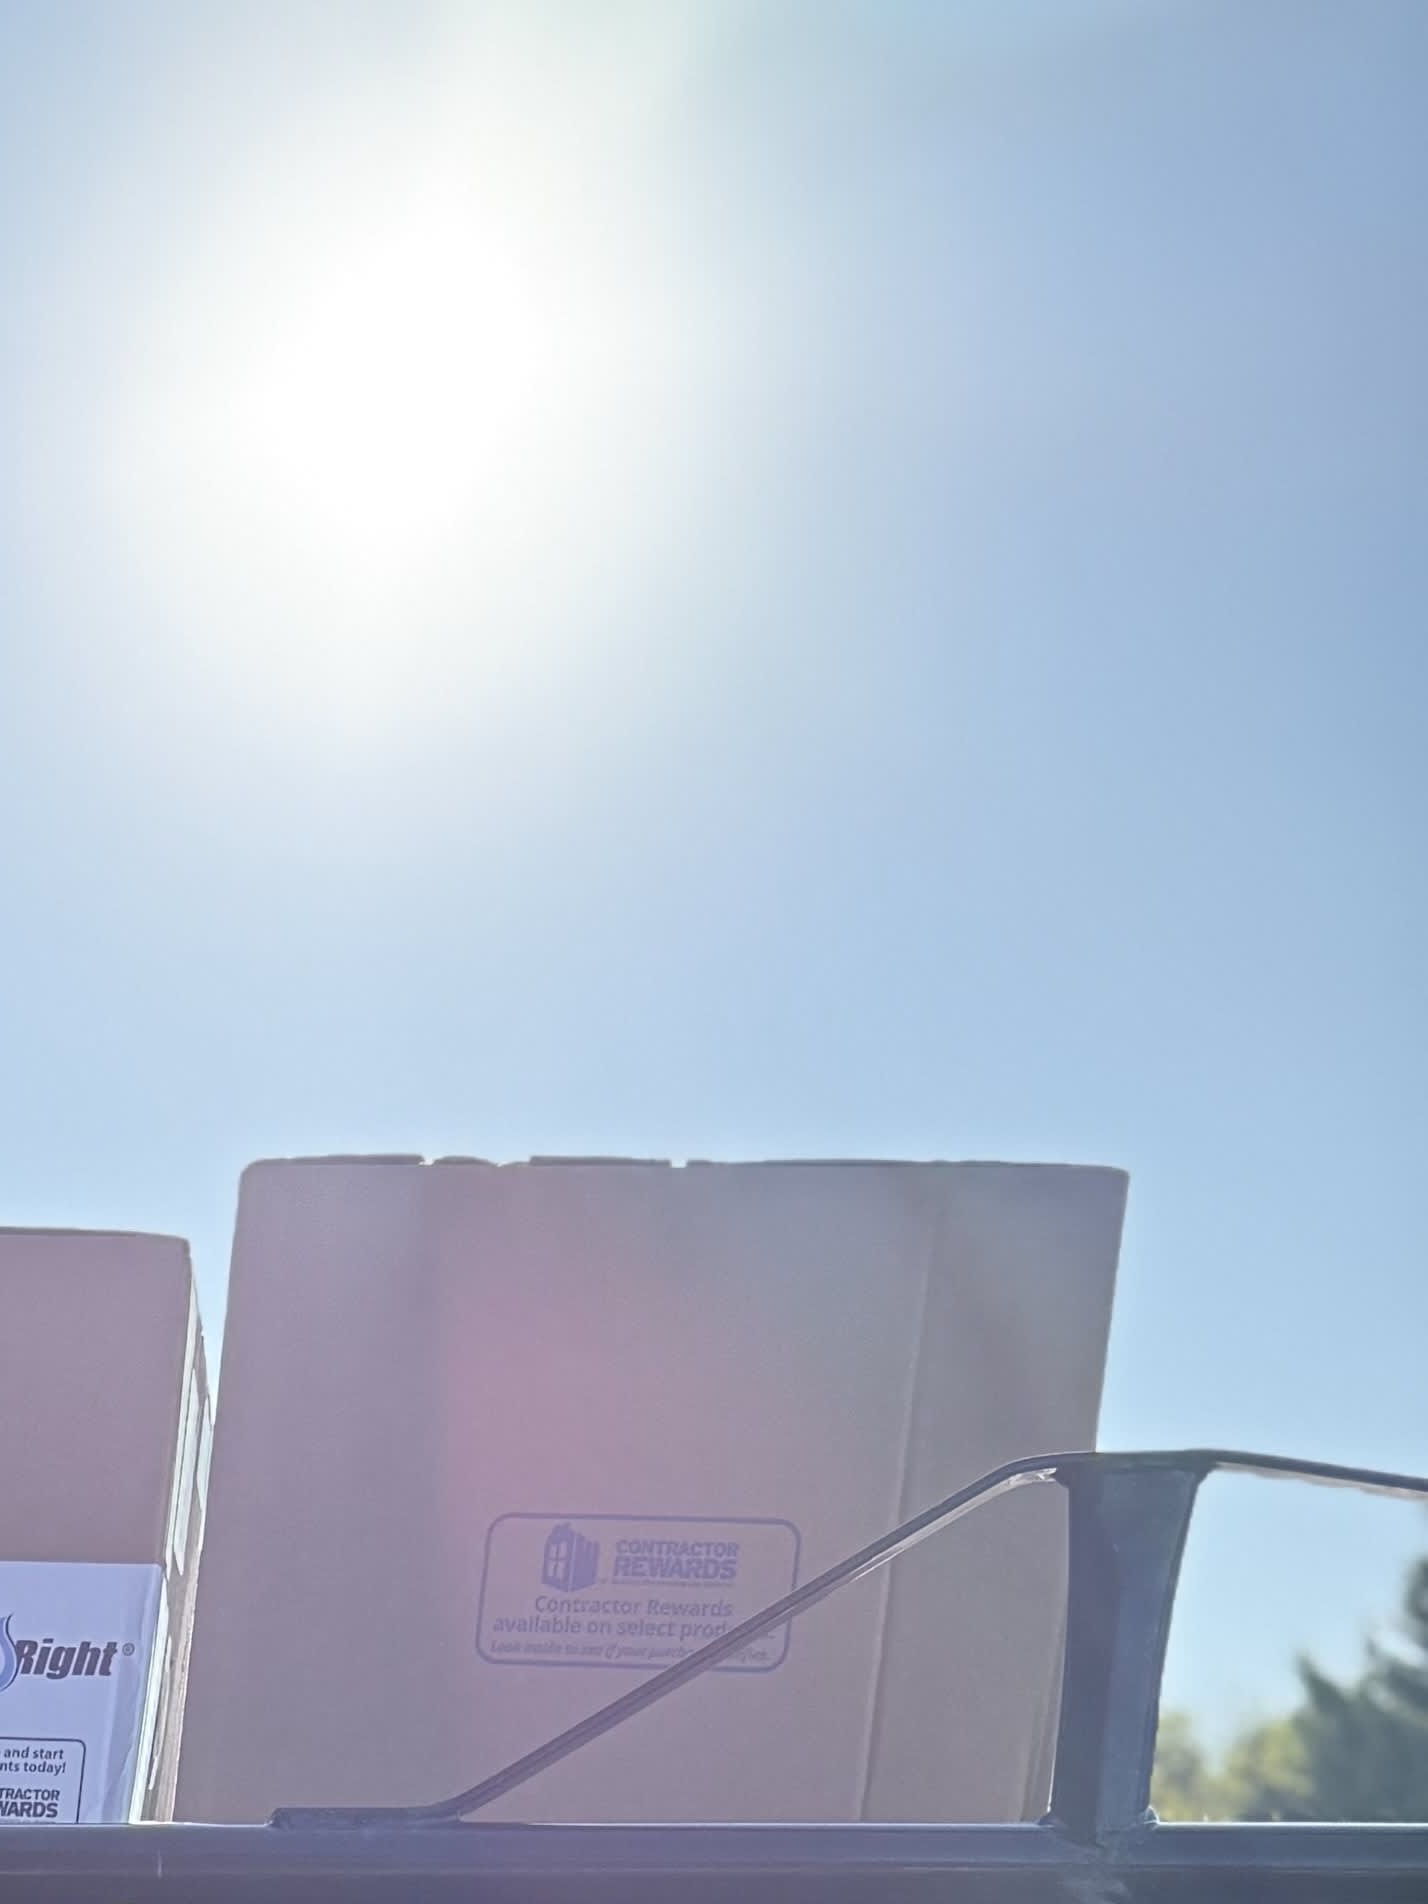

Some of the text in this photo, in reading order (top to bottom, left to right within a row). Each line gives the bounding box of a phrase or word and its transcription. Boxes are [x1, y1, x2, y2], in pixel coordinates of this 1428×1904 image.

[615, 1540, 739, 1557] CONTRACTOR
[613, 1556, 738, 1580] REWARDS
[535, 1595, 732, 1617] Contractor Rewards
[493, 1615, 582, 1634] available
[587, 1621, 612, 1634] on
[616, 1619, 676, 1637] select
[4, 1746, 29, 1759] and
[33, 1748, 64, 1760] start
[23, 1762, 66, 1776] today!
